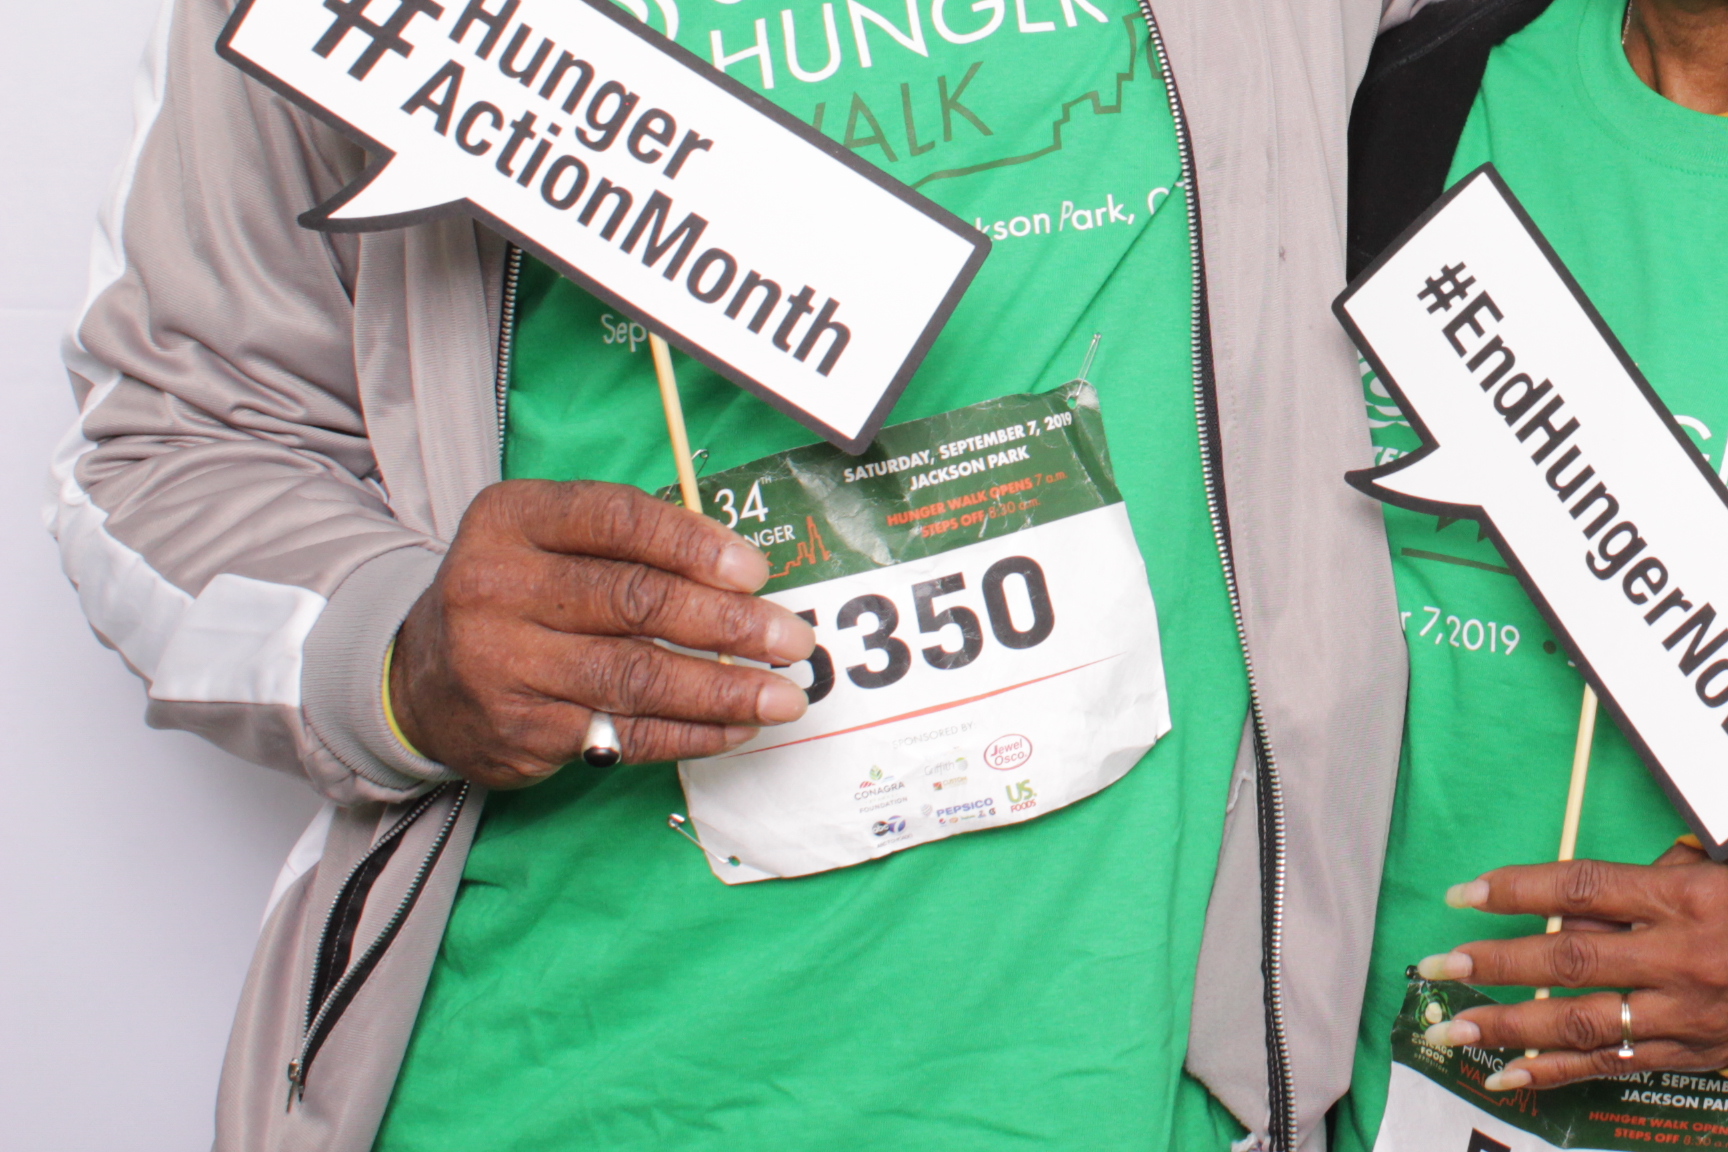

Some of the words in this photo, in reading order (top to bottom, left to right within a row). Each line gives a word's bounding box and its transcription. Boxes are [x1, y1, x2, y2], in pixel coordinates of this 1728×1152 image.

[813, 61, 994, 162] ALK
[400, 59, 852, 377] ActionMonth
[975, 213, 1050, 241] kson
[1059, 194, 1135, 231] Park,
[844, 449, 935, 483] SATURDAY,
[940, 425, 1027, 460] SEPTEMBER
[1027, 420, 1041, 437] 7,
[1044, 412, 1073, 431] 2019
[910, 459, 986, 491] JACKSON
[988, 445, 1030, 468] PARK
[887, 501, 946, 527] HUNGER
[947, 491, 988, 510] WALK
[989, 477, 1034, 499] OPENS
[1034, 473, 1044, 486] 7
[921, 520, 959, 538] STEPS
[960, 510, 986, 528] OFF
[988, 501, 1017, 520] 8:30
[744, 524, 795, 548] NGER
[892, 726, 958, 749] SPONSORED
[990, 739, 1022, 757] Jewel
[854, 780, 906, 800] CONAGRA
[859, 796, 908, 814] FOUNDATION
[936, 797, 994, 818] PEPSICO
[1010, 799, 1037, 813] FOODS
[1420, 1047, 1445, 1065] FOOD
[1462, 1045, 1507, 1072] HUNG
[1460, 1060, 1488, 1087] WAL
[1620, 1089, 1698, 1109] JACKSON
[1589, 1111, 1647, 1126] HUNGER
[1650, 1118, 1688, 1130] WALK
[1614, 1128, 1652, 1141] STEPS
[1655, 1132, 1680, 1144] OFF
